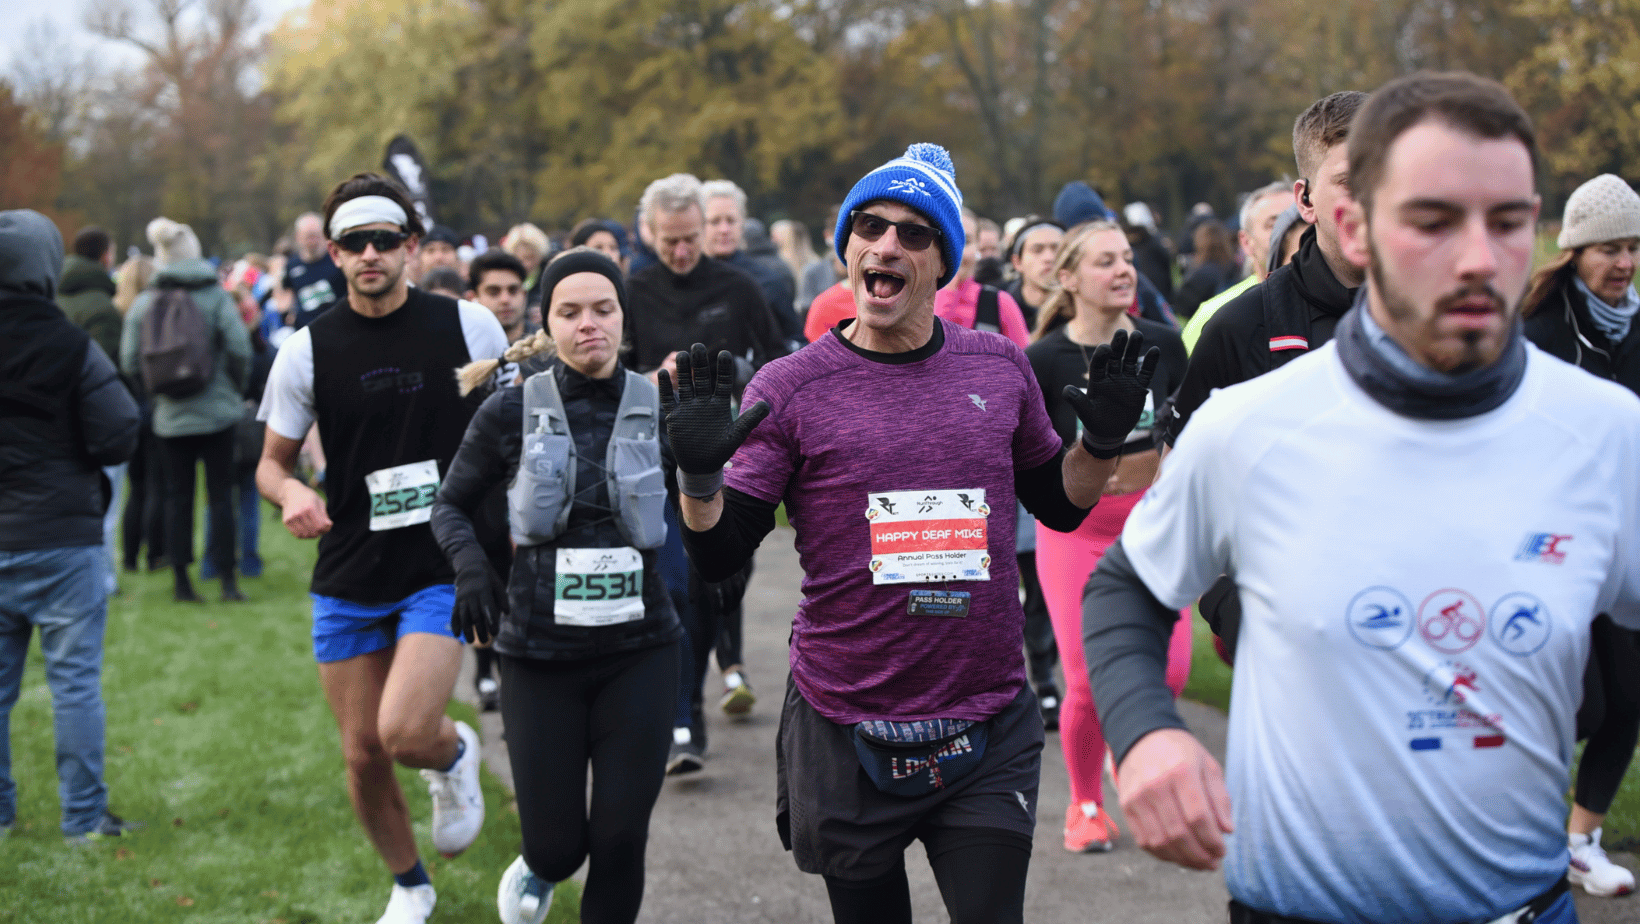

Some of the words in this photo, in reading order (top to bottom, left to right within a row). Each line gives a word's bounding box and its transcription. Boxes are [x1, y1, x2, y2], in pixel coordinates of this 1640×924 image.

[374, 484, 437, 516] 2523
[876, 531, 919, 543] HAPPY
[921, 529, 952, 540] DEAF
[954, 528, 983, 539] MIKE
[897, 553, 924, 562] Annual
[562, 571, 639, 600] 2531
